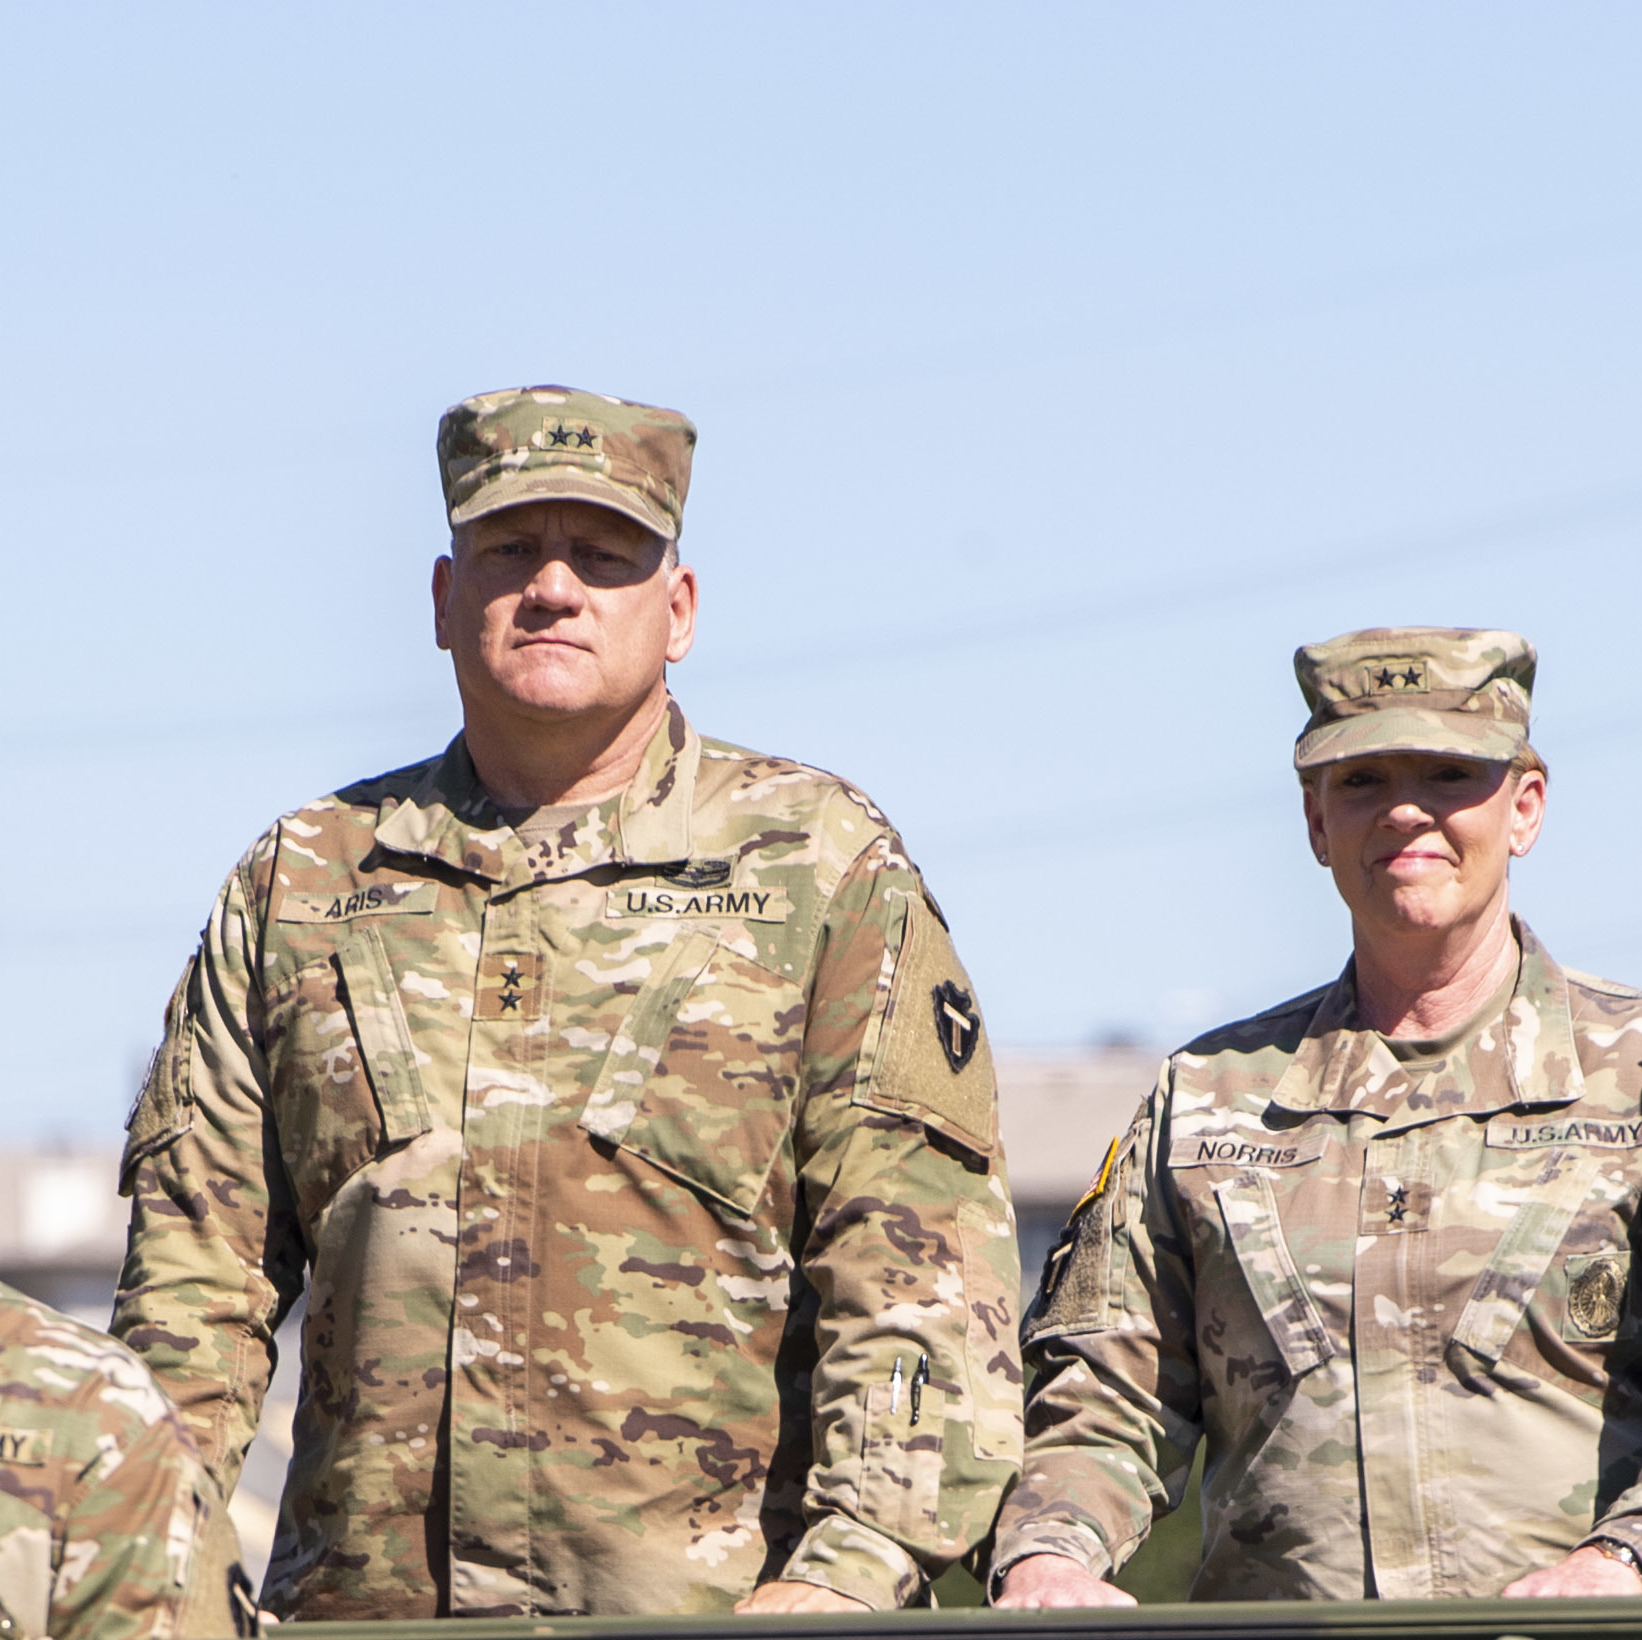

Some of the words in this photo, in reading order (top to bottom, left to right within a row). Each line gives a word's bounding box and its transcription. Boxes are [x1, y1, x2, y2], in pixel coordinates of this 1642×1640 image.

[324, 888, 383, 918] ARIS
[626, 891, 771, 915] U.S.ARMY
[1197, 1140, 1298, 1164] NORRIS
